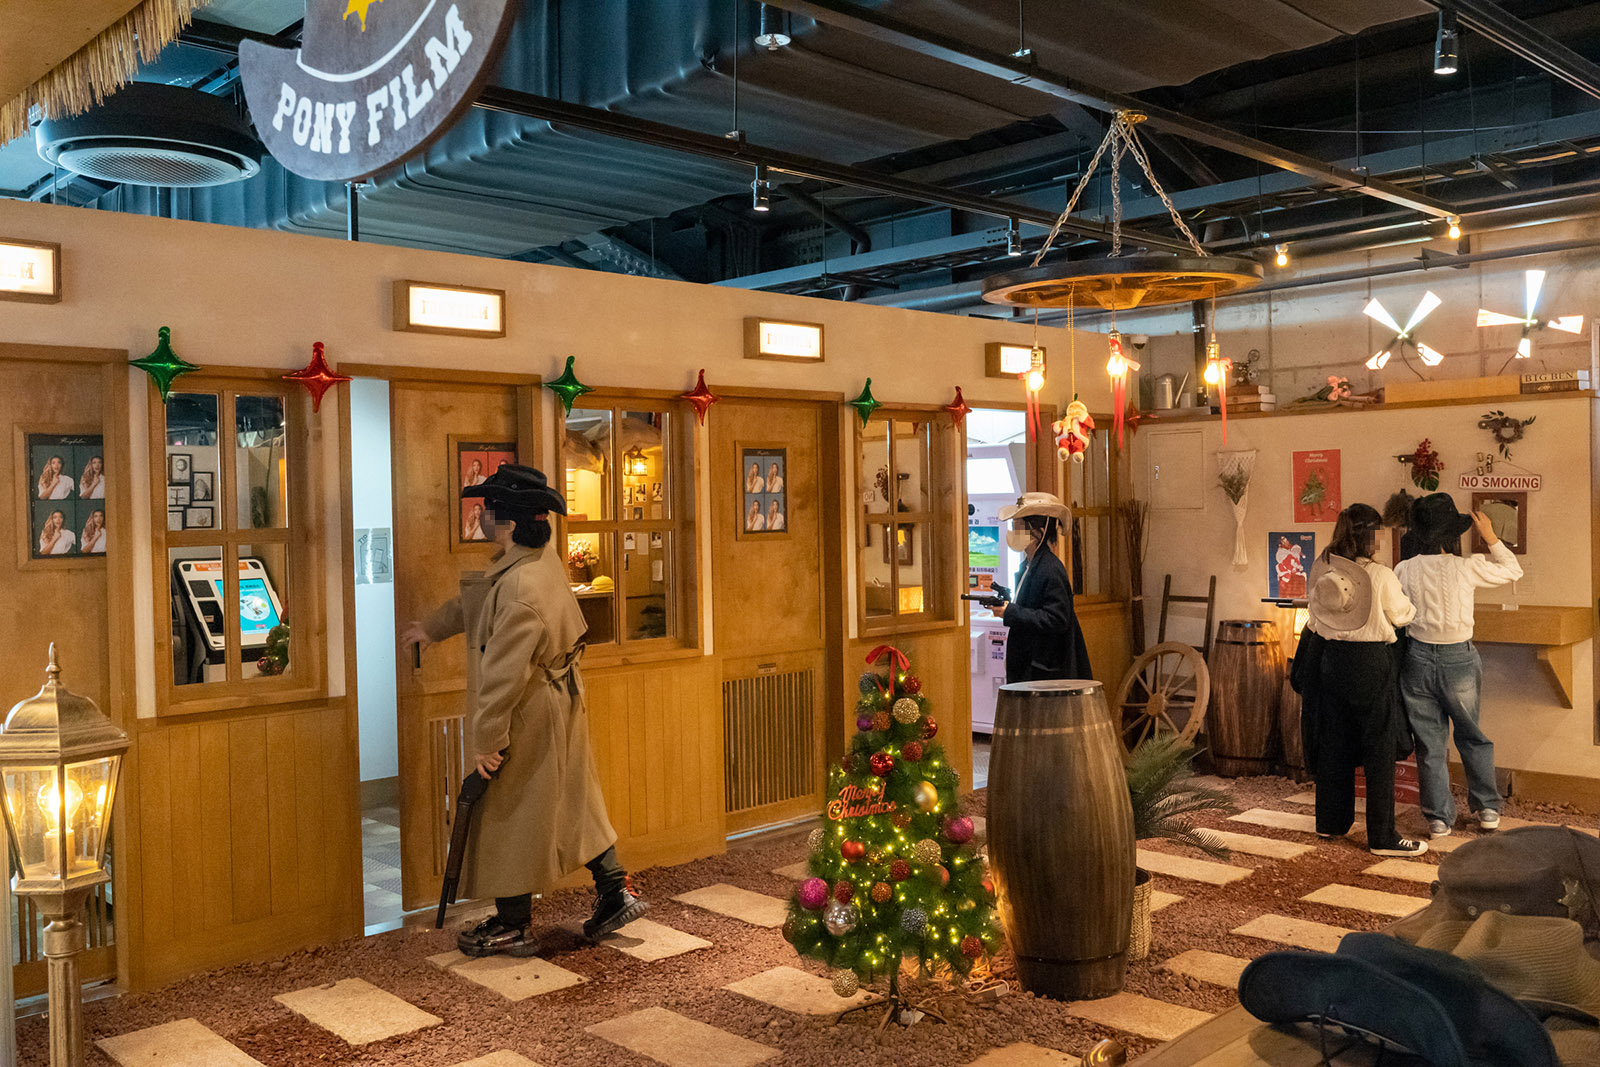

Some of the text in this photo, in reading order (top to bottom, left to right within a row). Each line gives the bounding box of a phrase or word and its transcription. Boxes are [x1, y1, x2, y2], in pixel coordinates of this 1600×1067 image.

[272, 3, 473, 154] PONY FILM
[1525, 371, 1574, 382] BIG BEN
[1461, 476, 1539, 489] NO SMOKING
[357, 534, 368, 544] TIP
[838, 781, 887, 802] Merry
[828, 799, 897, 820] Christmas
